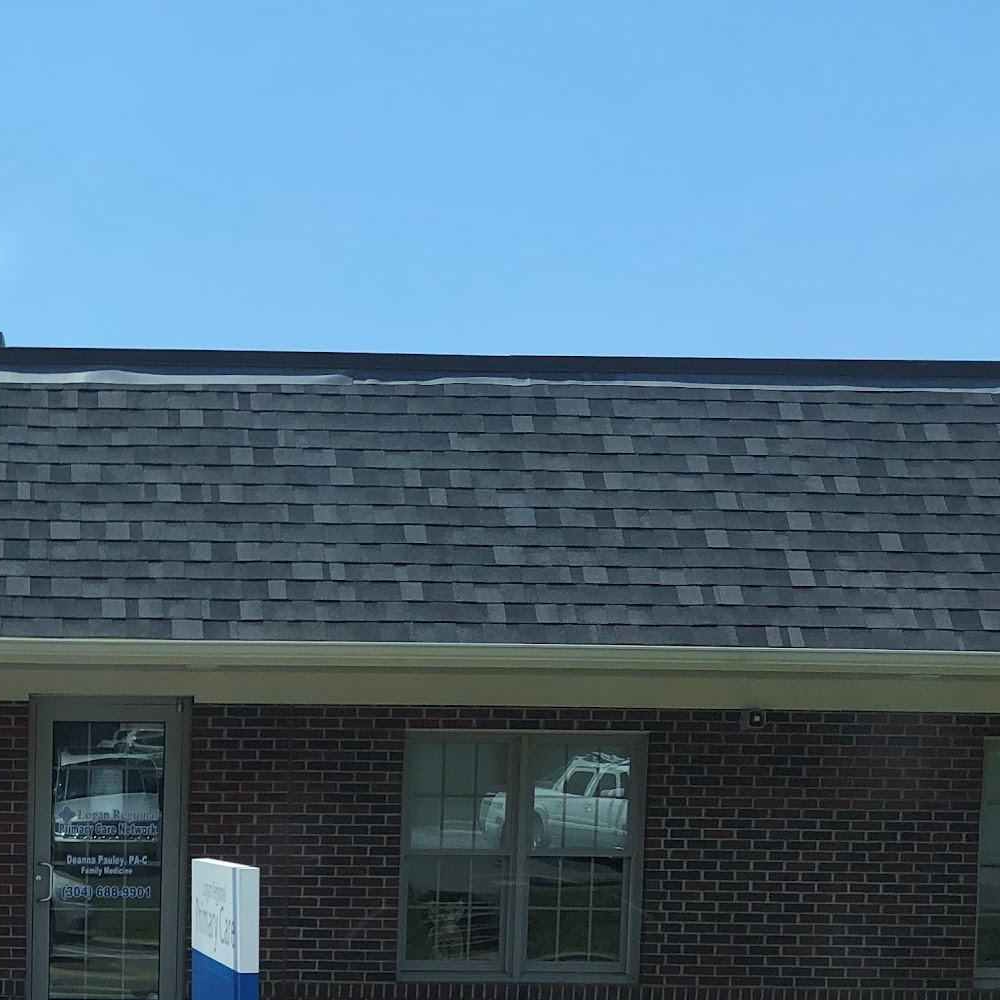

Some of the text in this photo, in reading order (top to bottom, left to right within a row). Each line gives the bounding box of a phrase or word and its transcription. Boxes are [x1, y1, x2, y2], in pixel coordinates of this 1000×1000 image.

[78, 809, 159, 824] Logan Regional
[58, 823, 158, 837] Primary Care Network
[67, 855, 148, 867] Deanna Pauley, PA-C
[81, 867, 133, 876] Family Medicine
[61, 885, 151, 900] (304) 688-9901
